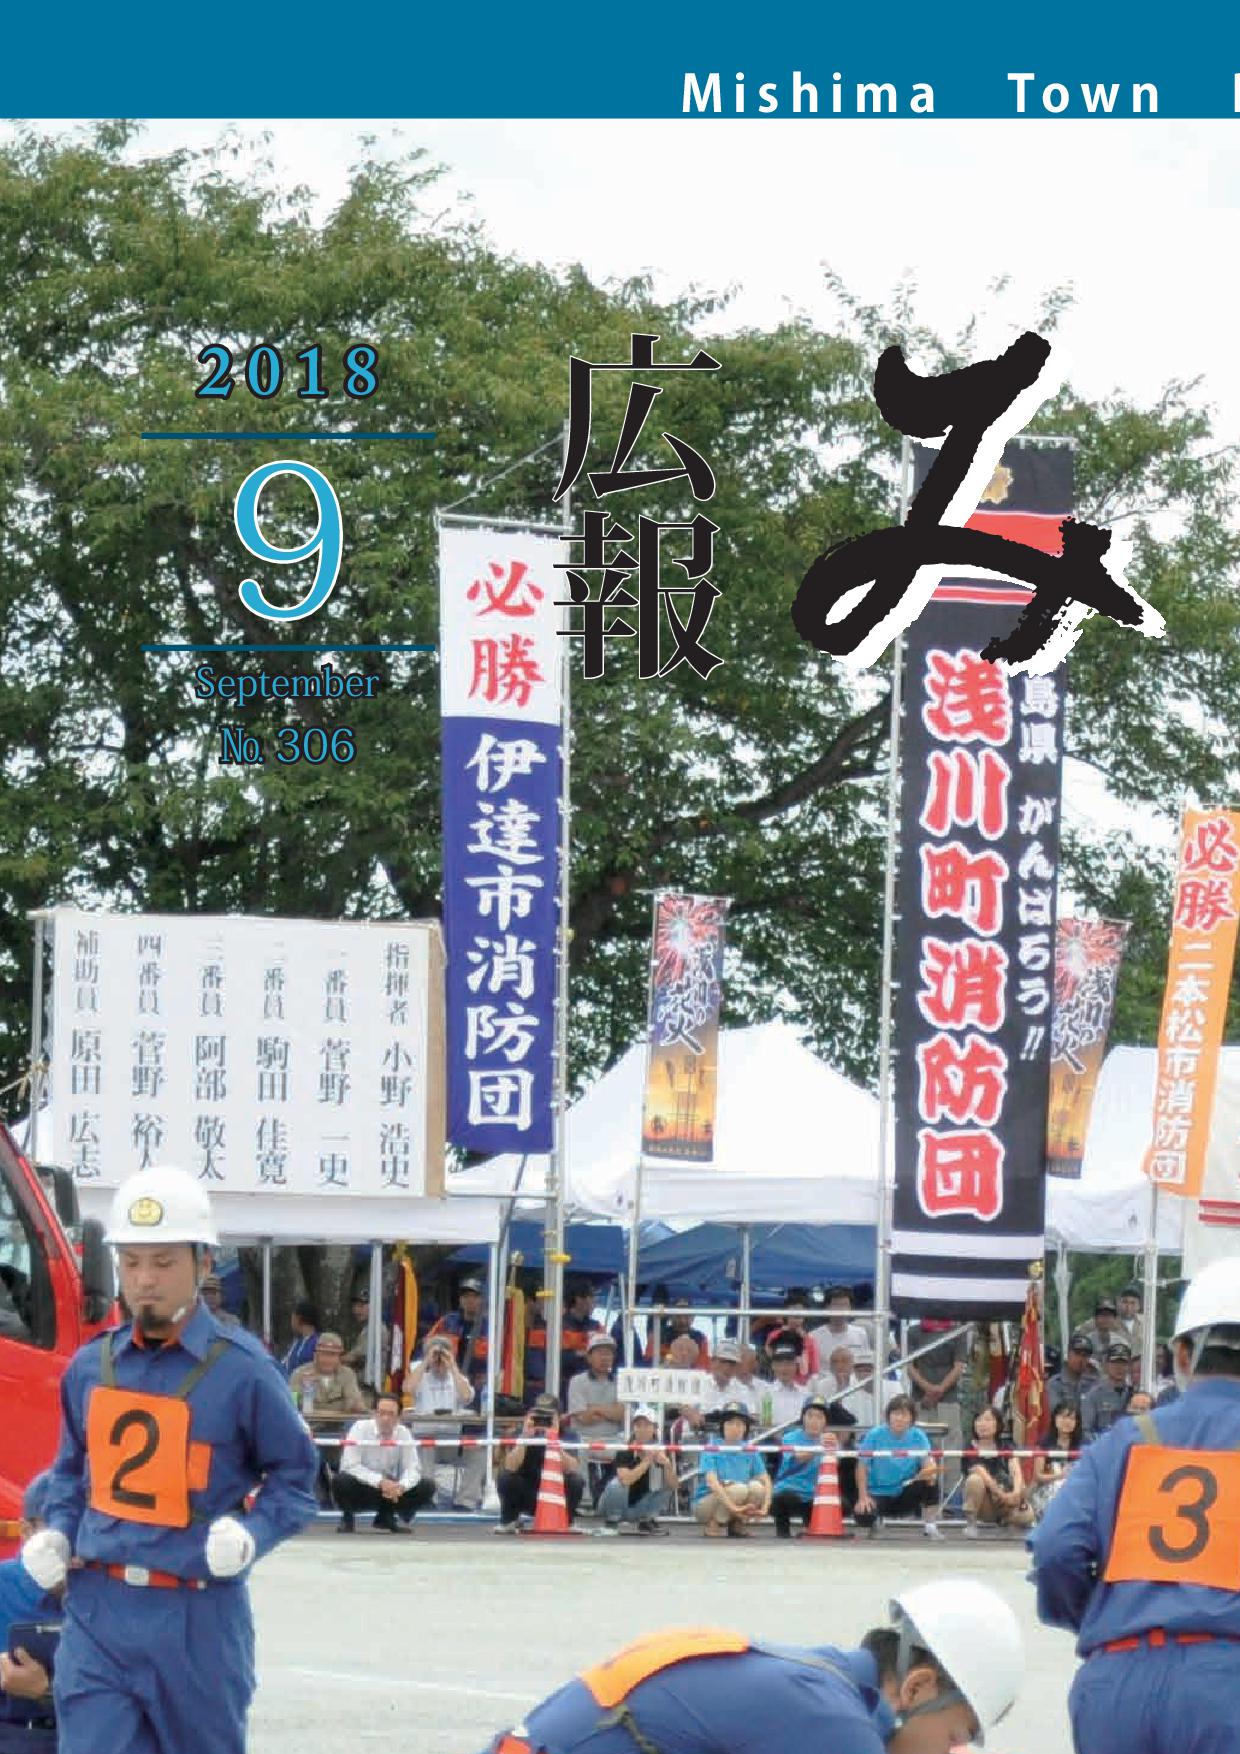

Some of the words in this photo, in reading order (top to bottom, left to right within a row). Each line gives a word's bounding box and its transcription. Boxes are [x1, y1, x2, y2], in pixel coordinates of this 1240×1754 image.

[466, 560, 545, 708] 必勝
[1174, 817, 1240, 932] 必勝
[464, 733, 548, 1132] 伊達市消防団
[916, 648, 1013, 1221] 浅川町消防団
[137, 935, 163, 1015] 四番員
[385, 941, 410, 1026] 指揮者
[71, 1028, 100, 1095] 原田
[132, 1030, 166, 1098] 菅野
[195, 1034, 227, 1101] 阿部
[256, 1035, 290, 1102] 駒田
[319, 1037, 350, 1106] 菅野
[380, 1040, 413, 1108] 小野
[69, 1110, 100, 1180] 広志
[195, 1113, 227, 1181] 敬太
[380, 1122, 411, 1189] 浩史
[110, 1409, 160, 1510] 2
[1149, 1466, 1218, 1562] 3
